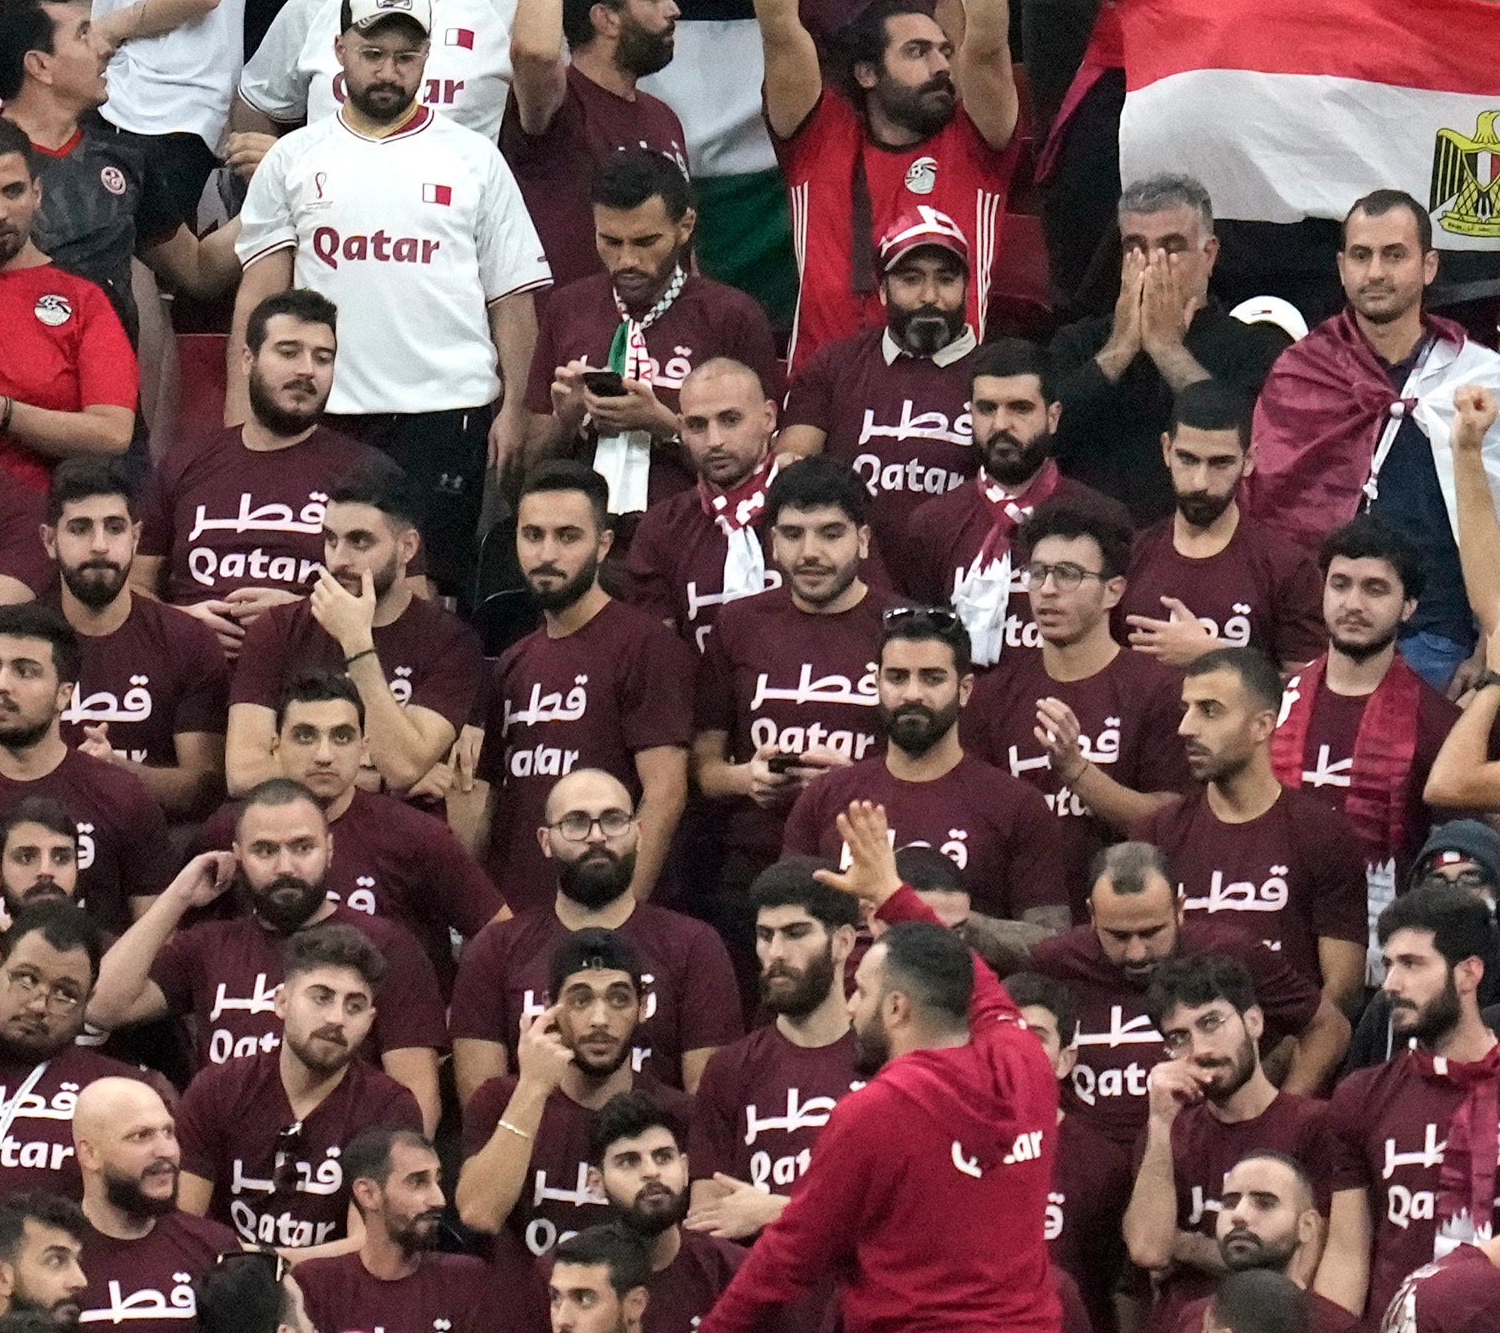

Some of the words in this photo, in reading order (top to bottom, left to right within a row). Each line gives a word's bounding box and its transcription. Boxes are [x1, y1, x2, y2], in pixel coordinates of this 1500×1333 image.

[312, 225, 441, 269] Qatar
[853, 454, 964, 496] Qatar
[189, 492, 326, 541] قطر
[189, 548, 322, 588] Qatar
[210, 973, 282, 1020] طر
[745, 1088, 837, 1144] طر
[79, 1273, 196, 1323] قط
